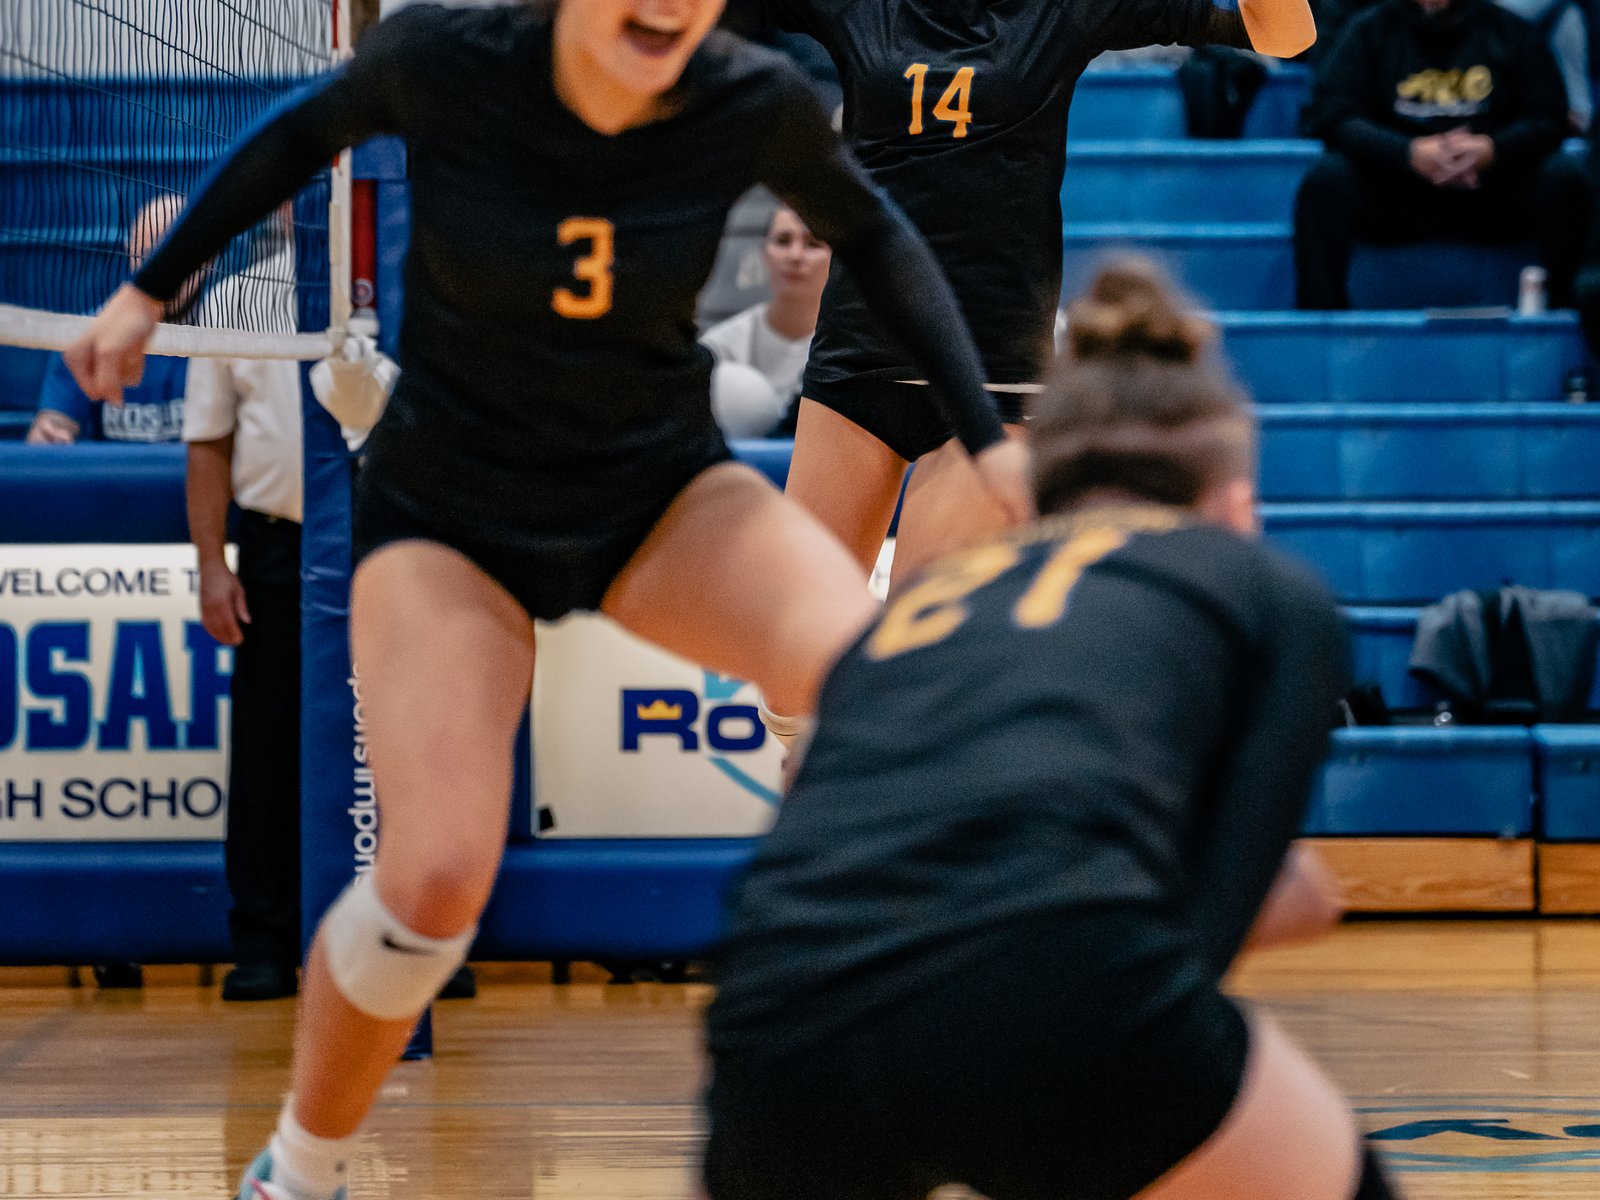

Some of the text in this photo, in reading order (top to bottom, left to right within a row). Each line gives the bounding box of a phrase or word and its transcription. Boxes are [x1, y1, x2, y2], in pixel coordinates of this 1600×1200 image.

[904, 63, 975, 139] 14
[551, 216, 614, 319] 3
[60, 777, 222, 820] SCHO
